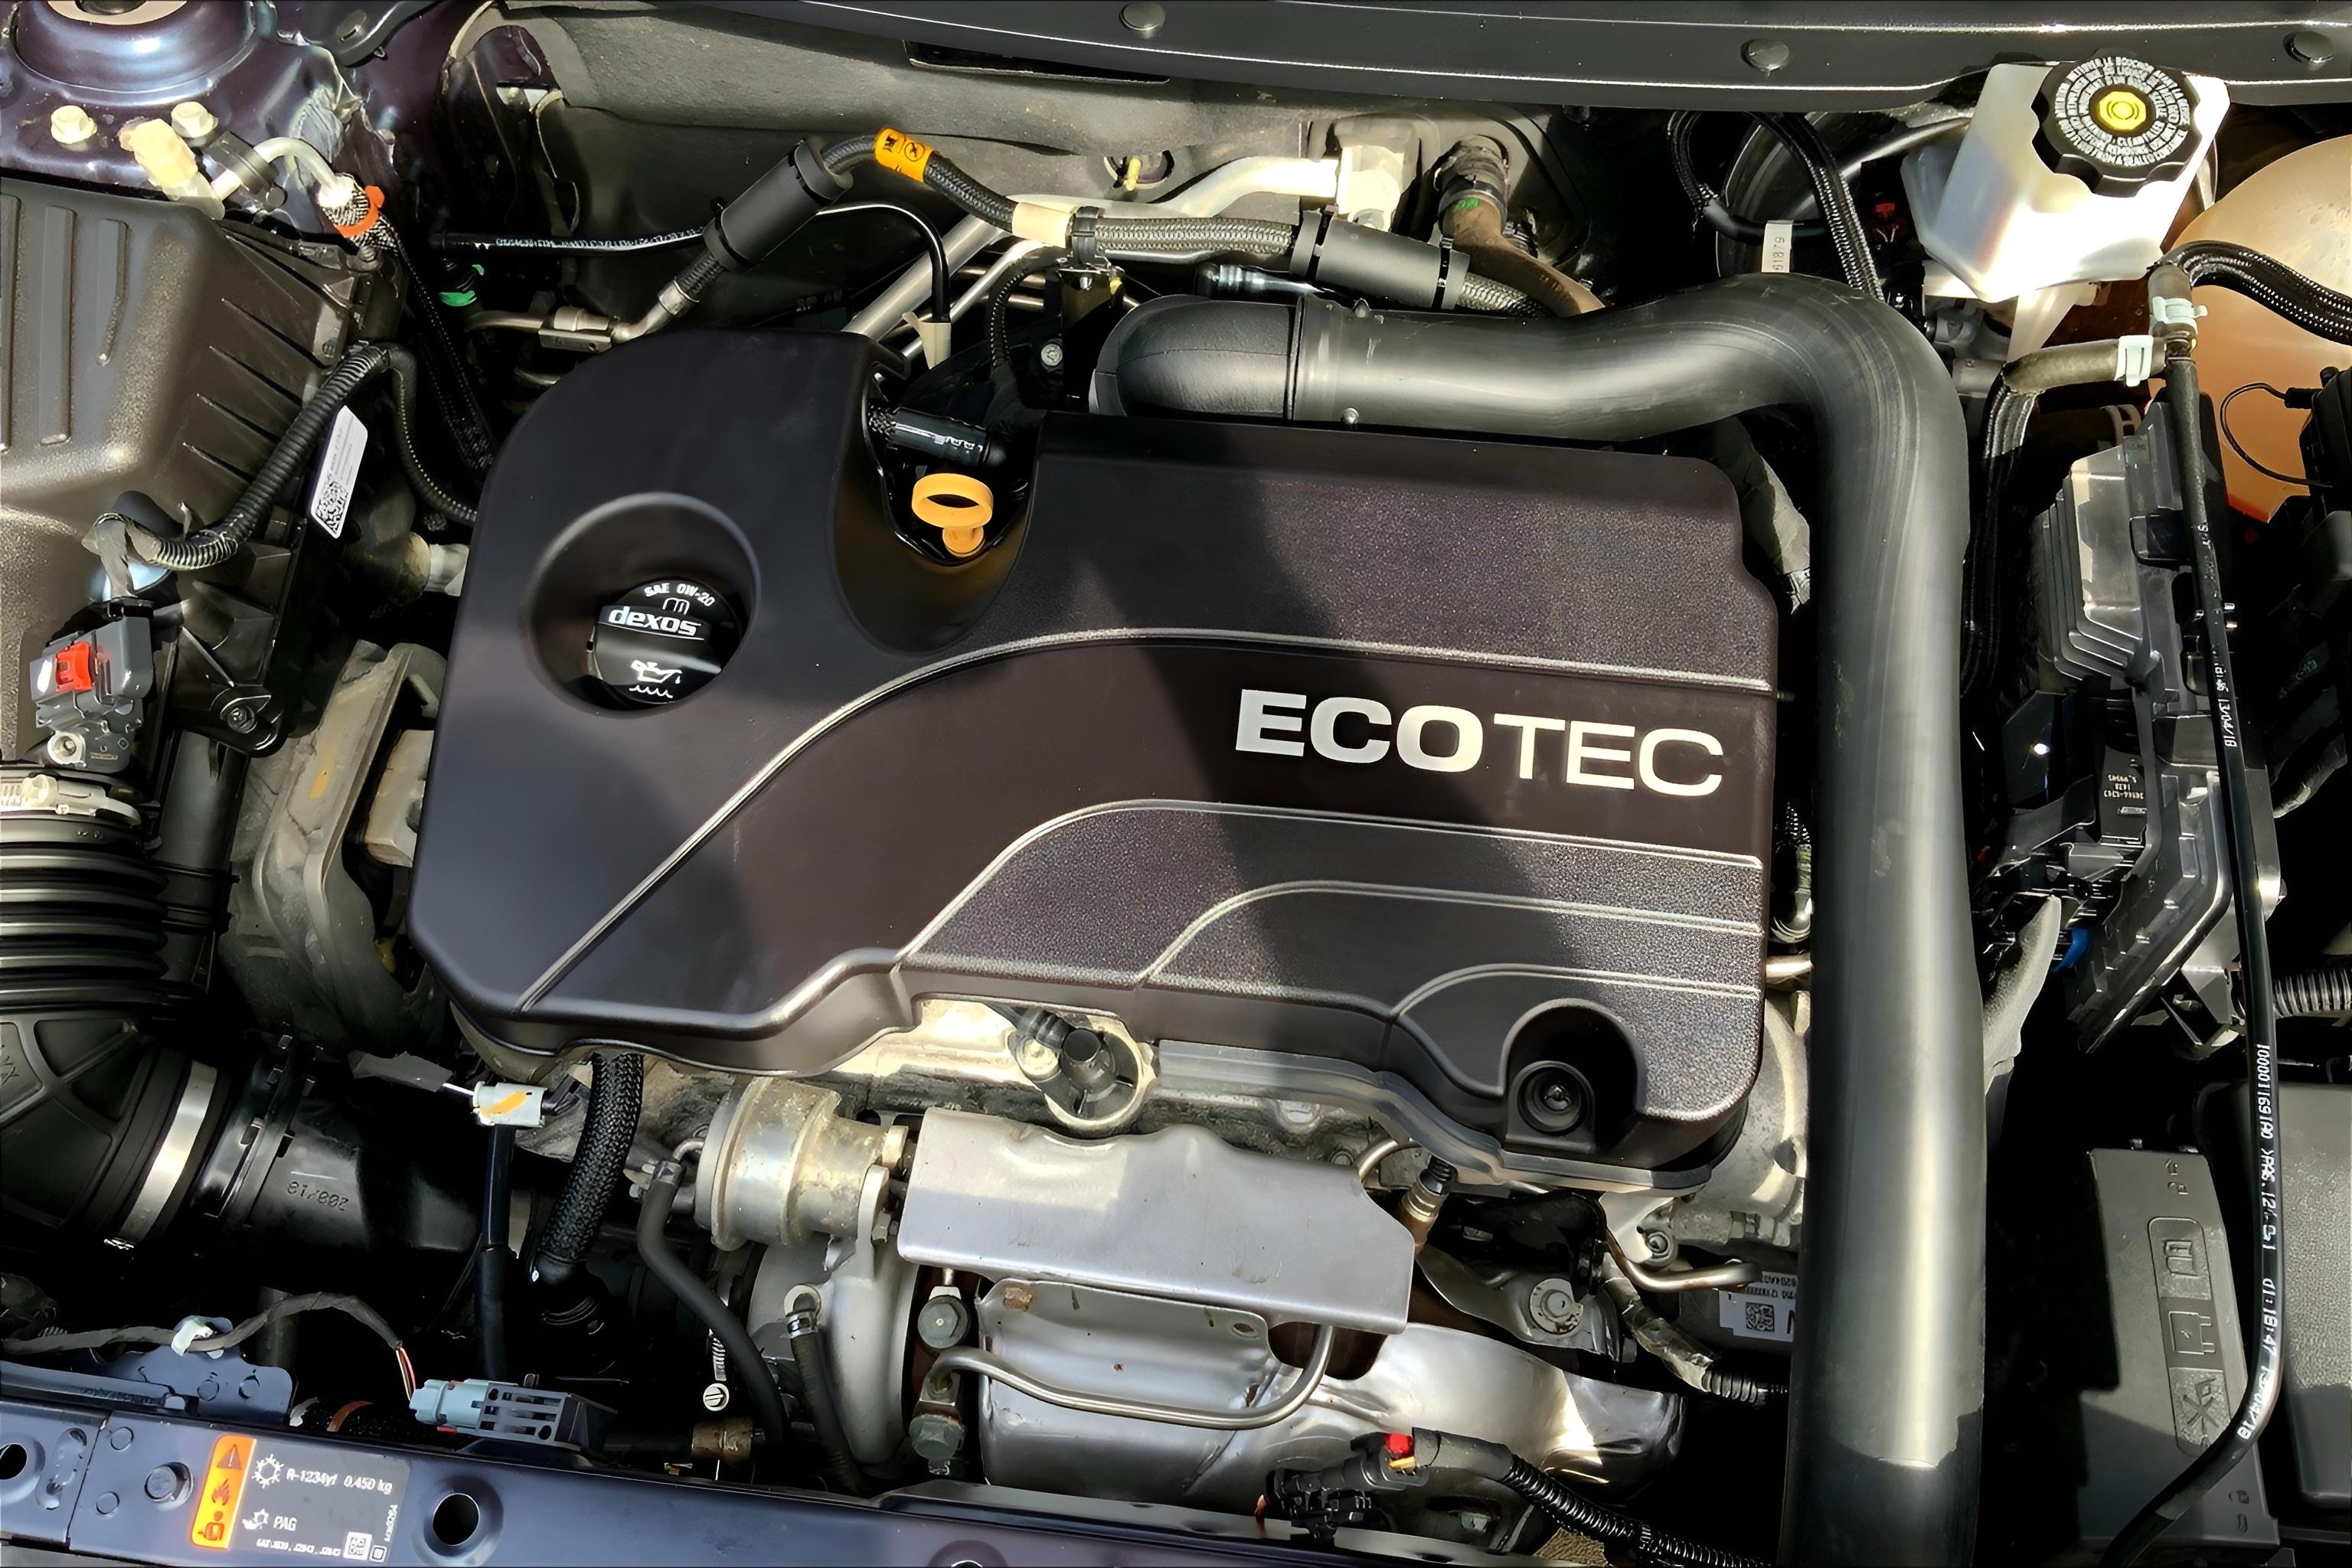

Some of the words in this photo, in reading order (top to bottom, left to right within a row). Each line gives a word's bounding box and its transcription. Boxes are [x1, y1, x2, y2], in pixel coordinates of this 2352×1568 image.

[644, 583, 671, 597] SAE
[676, 583, 717, 607] 0W-20
[608, 606, 702, 636] dexos
[1235, 688, 1724, 797] ECOTEC
[377, 1478, 393, 1495] kg
